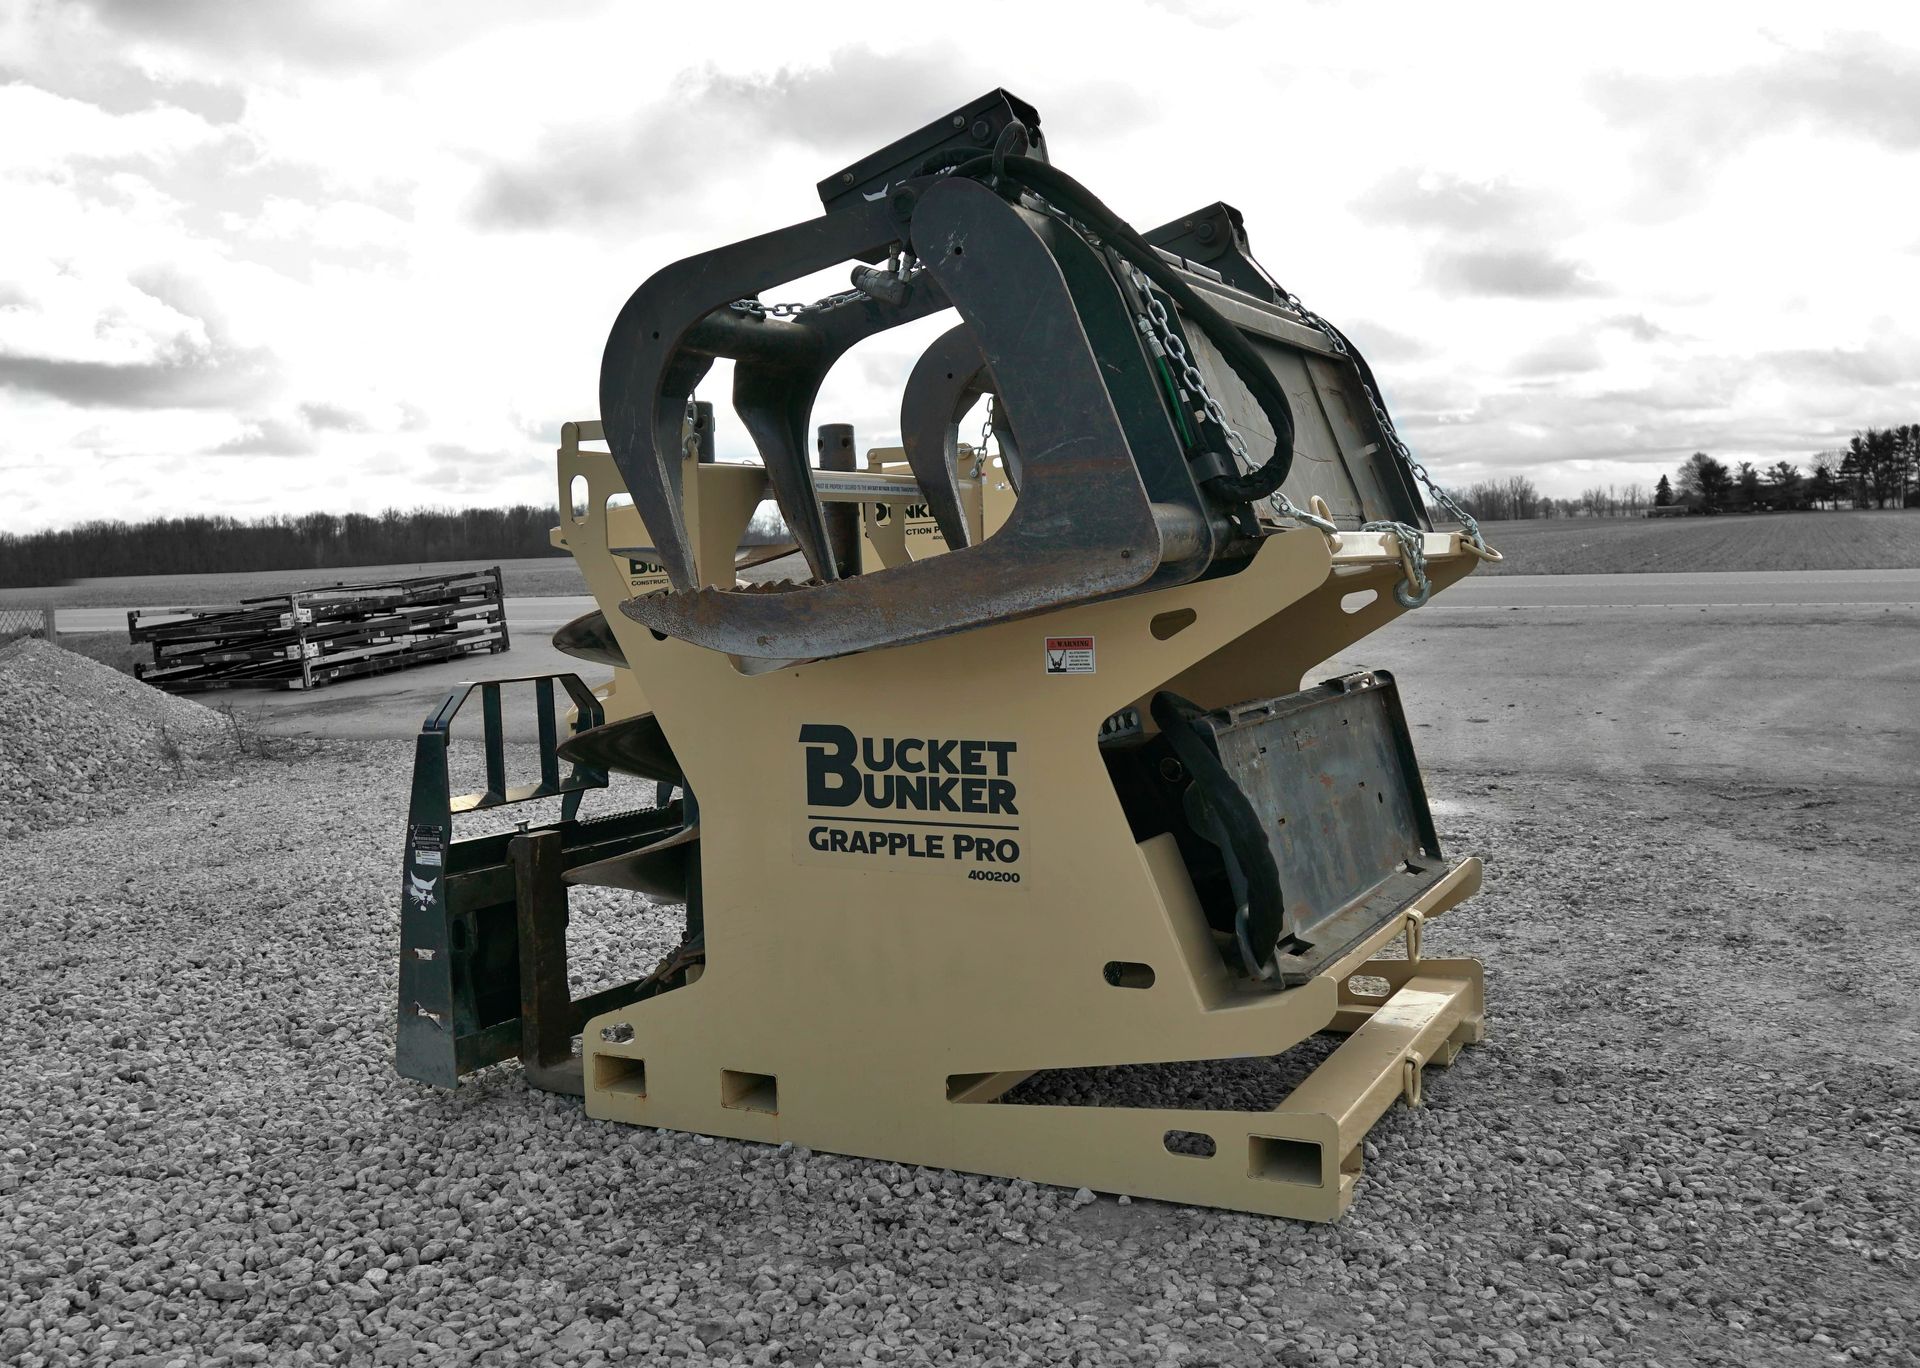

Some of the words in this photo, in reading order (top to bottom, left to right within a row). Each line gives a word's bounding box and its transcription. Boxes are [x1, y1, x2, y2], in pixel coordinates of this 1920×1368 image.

[1057, 640, 1089, 648] WARNING
[799, 724, 1017, 776] BUCKET
[806, 765, 1019, 815] BUNKER
[808, 826, 945, 859] GRAPPLE
[952, 834, 1020, 864] PRO
[968, 870, 1020, 883] 400200
